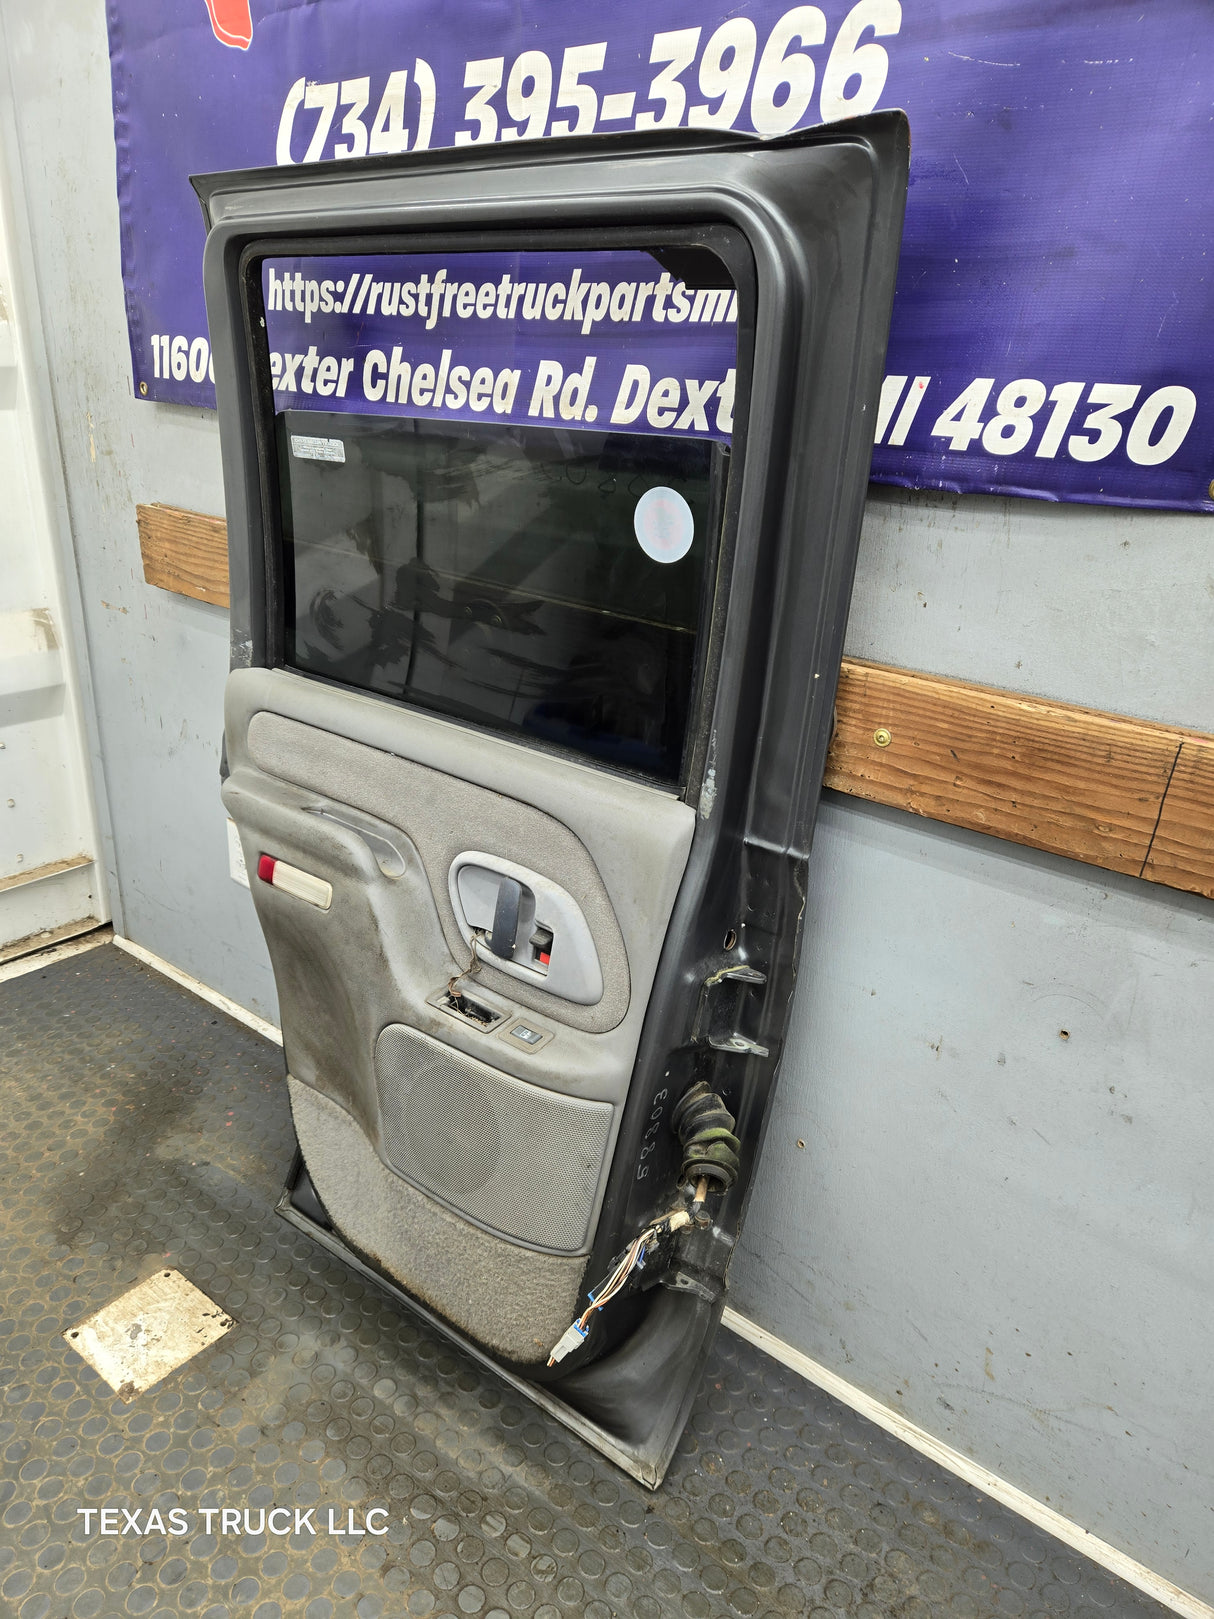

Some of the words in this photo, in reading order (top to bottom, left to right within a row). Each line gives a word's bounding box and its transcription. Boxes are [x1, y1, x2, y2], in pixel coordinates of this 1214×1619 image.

[276, 58, 437, 166] (734)
[454, 0, 902, 147] 395-3966
[269, 345, 355, 398] exter
[362, 347, 523, 413] Chelsea
[528, 356, 599, 423] Rd.
[610, 364, 737, 434] Dext
[930, 376, 1198, 466] 48130
